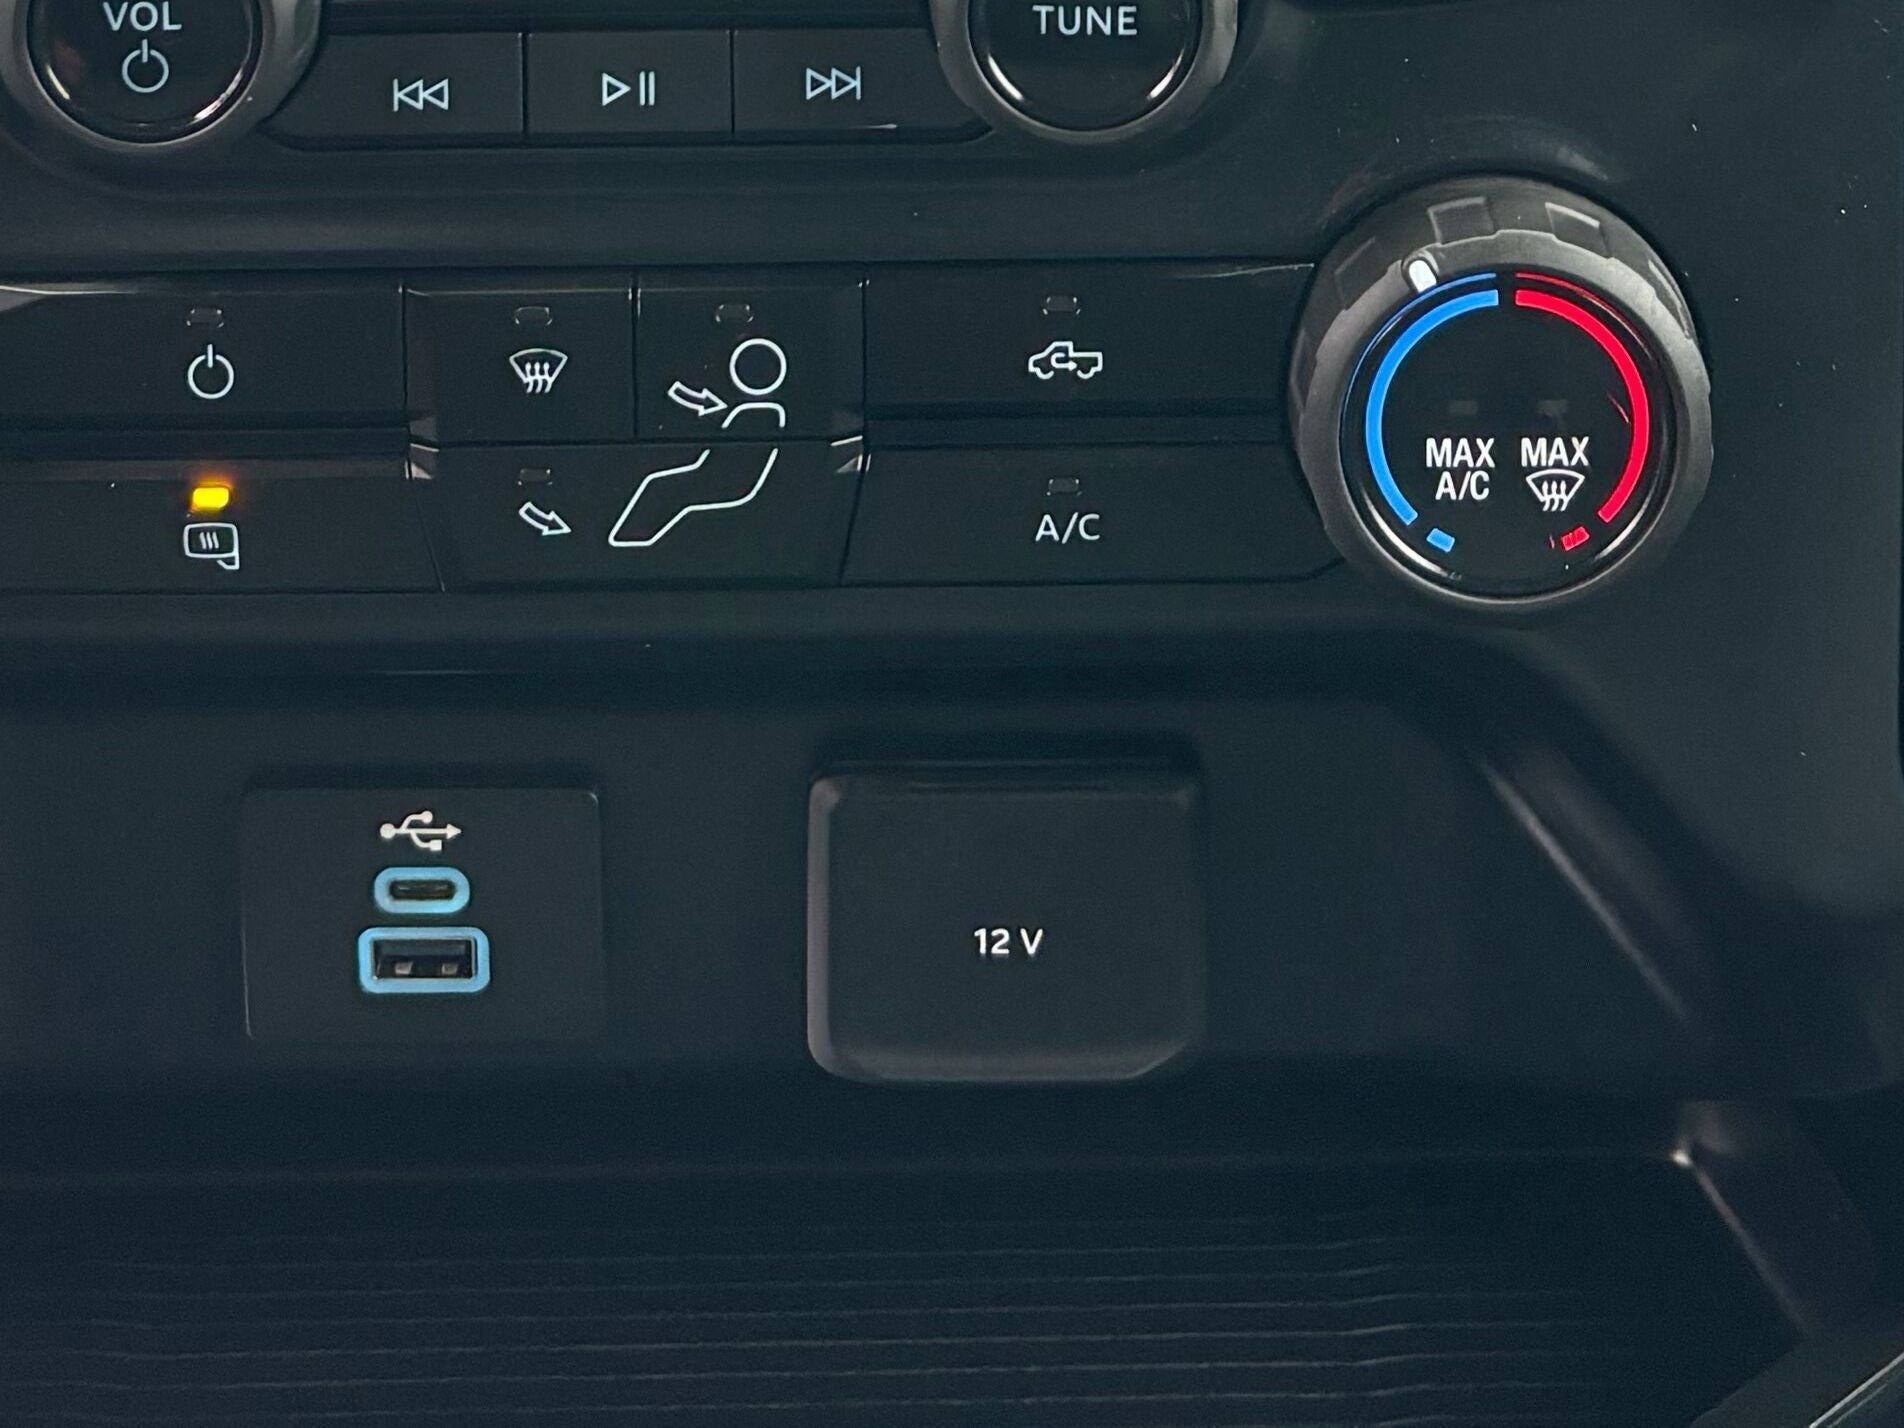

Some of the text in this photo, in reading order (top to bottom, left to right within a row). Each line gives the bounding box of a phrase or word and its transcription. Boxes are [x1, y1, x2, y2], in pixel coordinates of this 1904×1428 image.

[103, 1, 182, 32] VOL
[1032, 5, 1138, 36] TUNE
[1426, 437, 1495, 468] MAX
[1521, 436, 1589, 467] MAX
[1435, 470, 1490, 501] A/C
[1035, 512, 1100, 544] A/C
[974, 928, 1043, 955] 12 V
